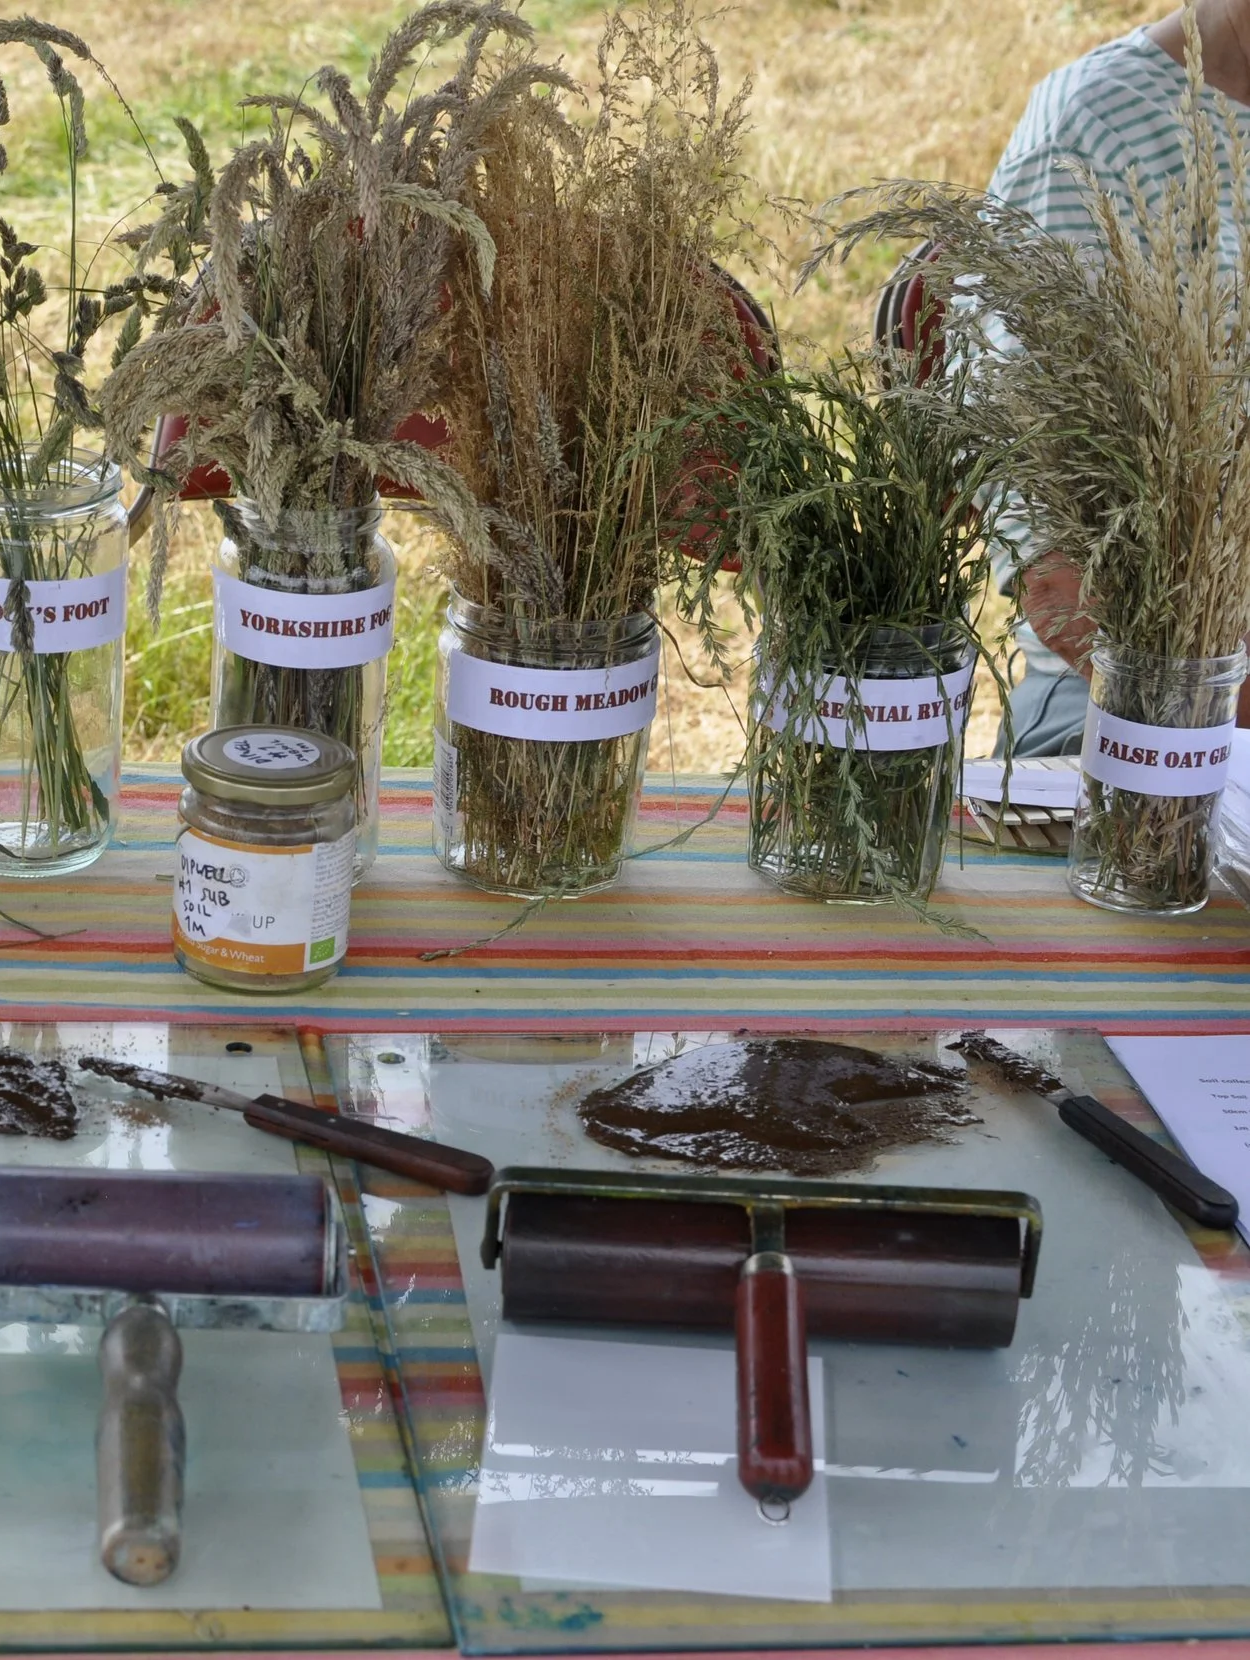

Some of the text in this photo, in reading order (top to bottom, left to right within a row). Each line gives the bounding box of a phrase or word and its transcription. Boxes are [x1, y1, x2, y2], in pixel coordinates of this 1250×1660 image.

[62, 596, 110, 622] FOOT
[239, 608, 366, 638] YORKSHIRE
[489, 687, 568, 712] ROUGH
[574, 679, 650, 712] MEADOW
[1099, 736, 1159, 767] FALSE
[1164, 750, 1207, 769] OAT
[183, 899, 213, 918] SOIL
[200, 887, 231, 907] SUB
[252, 915, 277, 930] UP
[220, 947, 229, 958] &
[229, 949, 265, 964] Wheat
